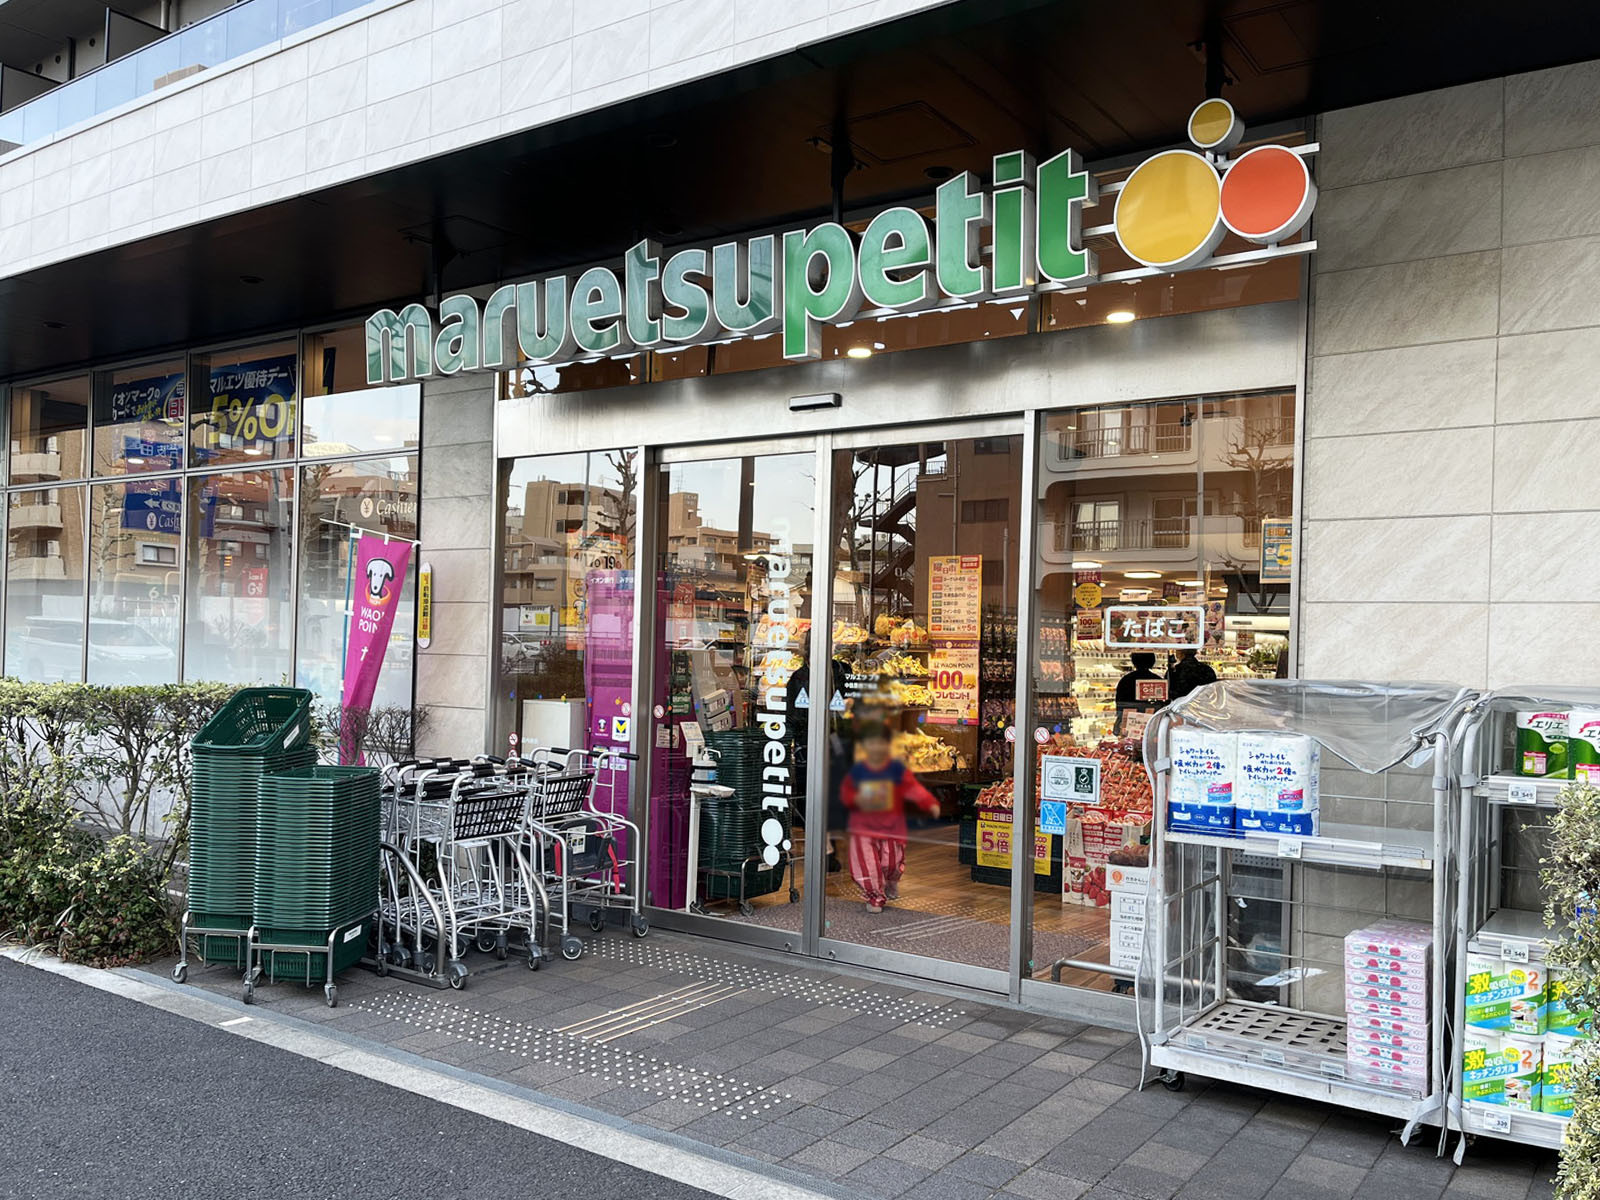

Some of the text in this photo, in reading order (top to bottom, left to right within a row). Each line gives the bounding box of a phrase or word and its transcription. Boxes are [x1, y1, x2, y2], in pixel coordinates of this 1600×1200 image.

[365, 147, 1090, 384] maruetsupetit
[361, 606, 386, 622] WAO
[1122, 616, 1186, 638] たばこ
[930, 670, 963, 690] 100
[982, 831, 995, 851] 5
[1473, 985, 1523, 1004] キッチンタオル
[1469, 1065, 1516, 1081] キッチンタオル
